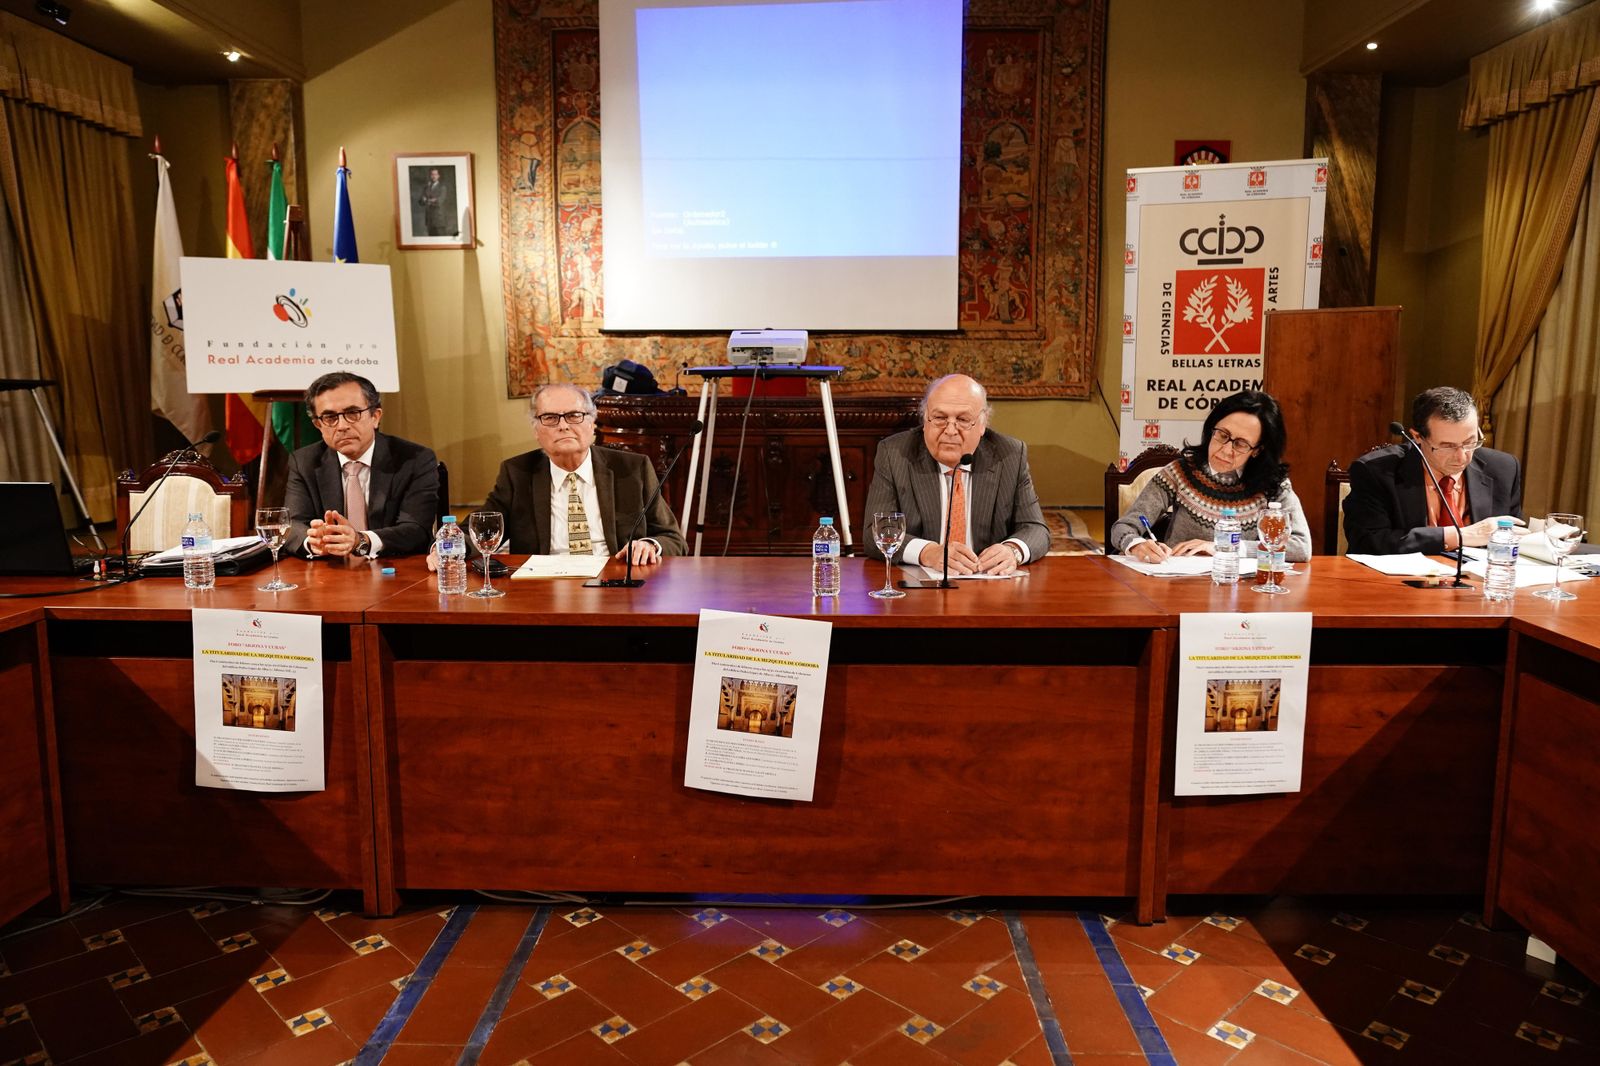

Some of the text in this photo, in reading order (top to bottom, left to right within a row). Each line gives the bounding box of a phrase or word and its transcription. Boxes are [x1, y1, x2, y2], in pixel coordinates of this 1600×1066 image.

[1268, 266, 1279, 303] ARTES
[1161, 282, 1172, 355] DE CIENCIAS
[208, 340, 326, 349] Fundación
[208, 354, 240, 365] Real
[246, 355, 315, 365] Academia
[337, 357, 379, 365] Córdoba
[1172, 358, 1261, 368] BELLAS LETRAS
[1147, 379, 1264, 391] REAL ACADEM
[1158, 398, 1178, 409] DE
